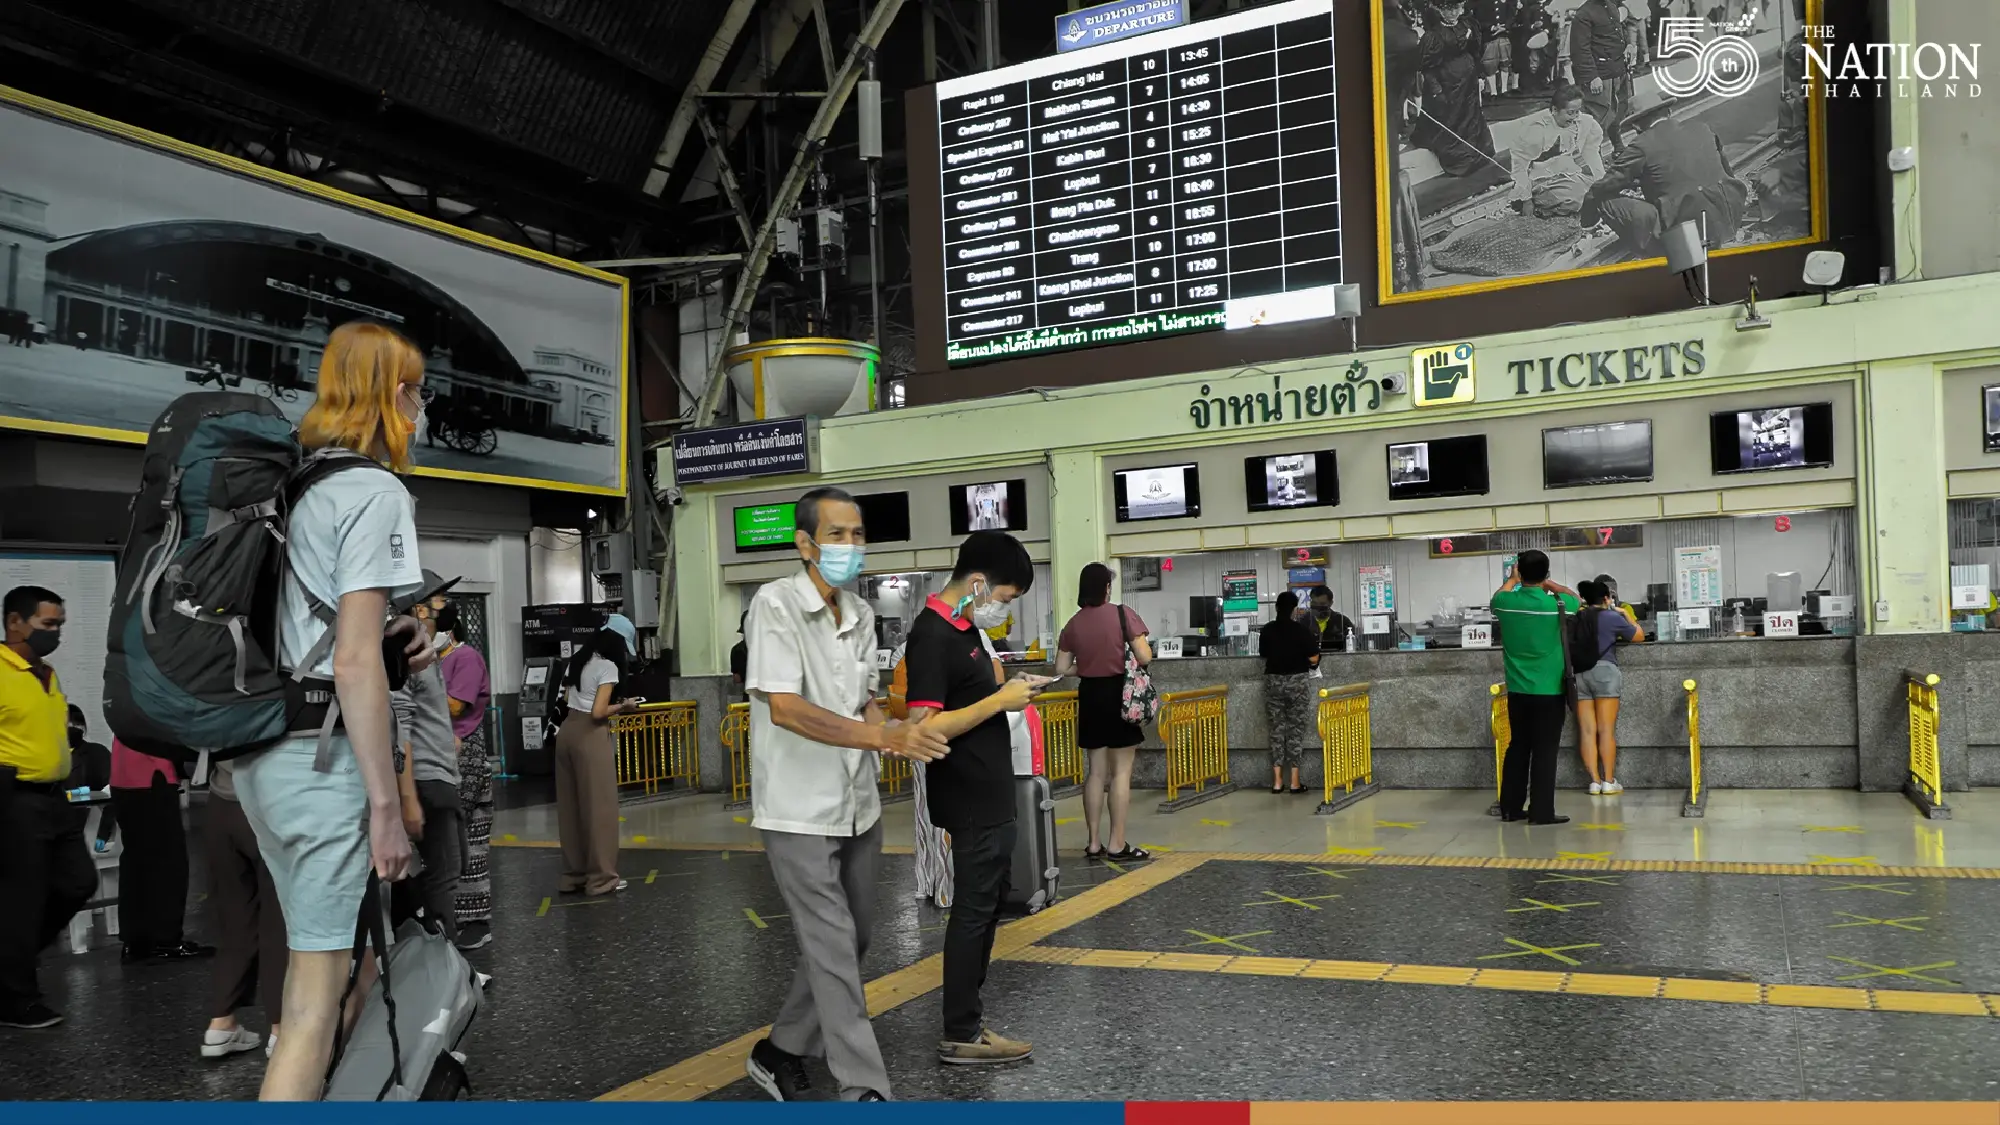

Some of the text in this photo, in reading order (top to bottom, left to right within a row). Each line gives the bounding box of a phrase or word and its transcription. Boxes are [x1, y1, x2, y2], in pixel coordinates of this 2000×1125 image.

[1094, 10, 1175, 38] DEPARTURE
[1180, 47, 1208, 61] 13:45
[1143, 59, 1155, 70] 10
[1052, 76, 1085, 90] Chiang
[1180, 73, 1209, 89] 14:05
[1146, 85, 1153, 96] 7
[1181, 100, 1210, 115] 14:30
[1146, 111, 1154, 121] 4
[1042, 121, 1119, 144] Hat Yai Junction
[1182, 126, 1211, 141] 15:25
[1056, 147, 1105, 166] Kabin Buri
[1148, 163, 1156, 173] 7
[1064, 174, 1100, 191] Lopburi
[1146, 189, 1158, 200] 11
[1094, 197, 1116, 209] Duk
[1048, 224, 1119, 243] Chachoengsao
[1186, 231, 1216, 246] 17:00
[1148, 241, 1161, 252] 10
[1070, 252, 1099, 265] Trang
[1186, 257, 1217, 272] 17:00
[1092, 273, 1133, 286] Junction
[1150, 292, 1161, 303] 11
[1189, 284, 1218, 298] 17:25
[1068, 301, 1104, 318] Lopburi
[1507, 339, 1706, 395] TICKETS
[1189, 359, 1383, 429] จำหน่ายตั๋ว
[677, 452, 804, 476] POSTPONEMENT OF JOURNEY OR REFUND OF FARES
[1774, 515, 1792, 532] 8
[1597, 527, 1613, 546] 7
[1440, 538, 1454, 554] 6
[1161, 557, 1174, 573] 4
[889, 575, 900, 590] 2
[525, 619, 541, 629] ATM
[1769, 615, 1794, 628] ปิด
[1466, 628, 1487, 640] ปิด
[1161, 640, 1180, 651] ปิด
